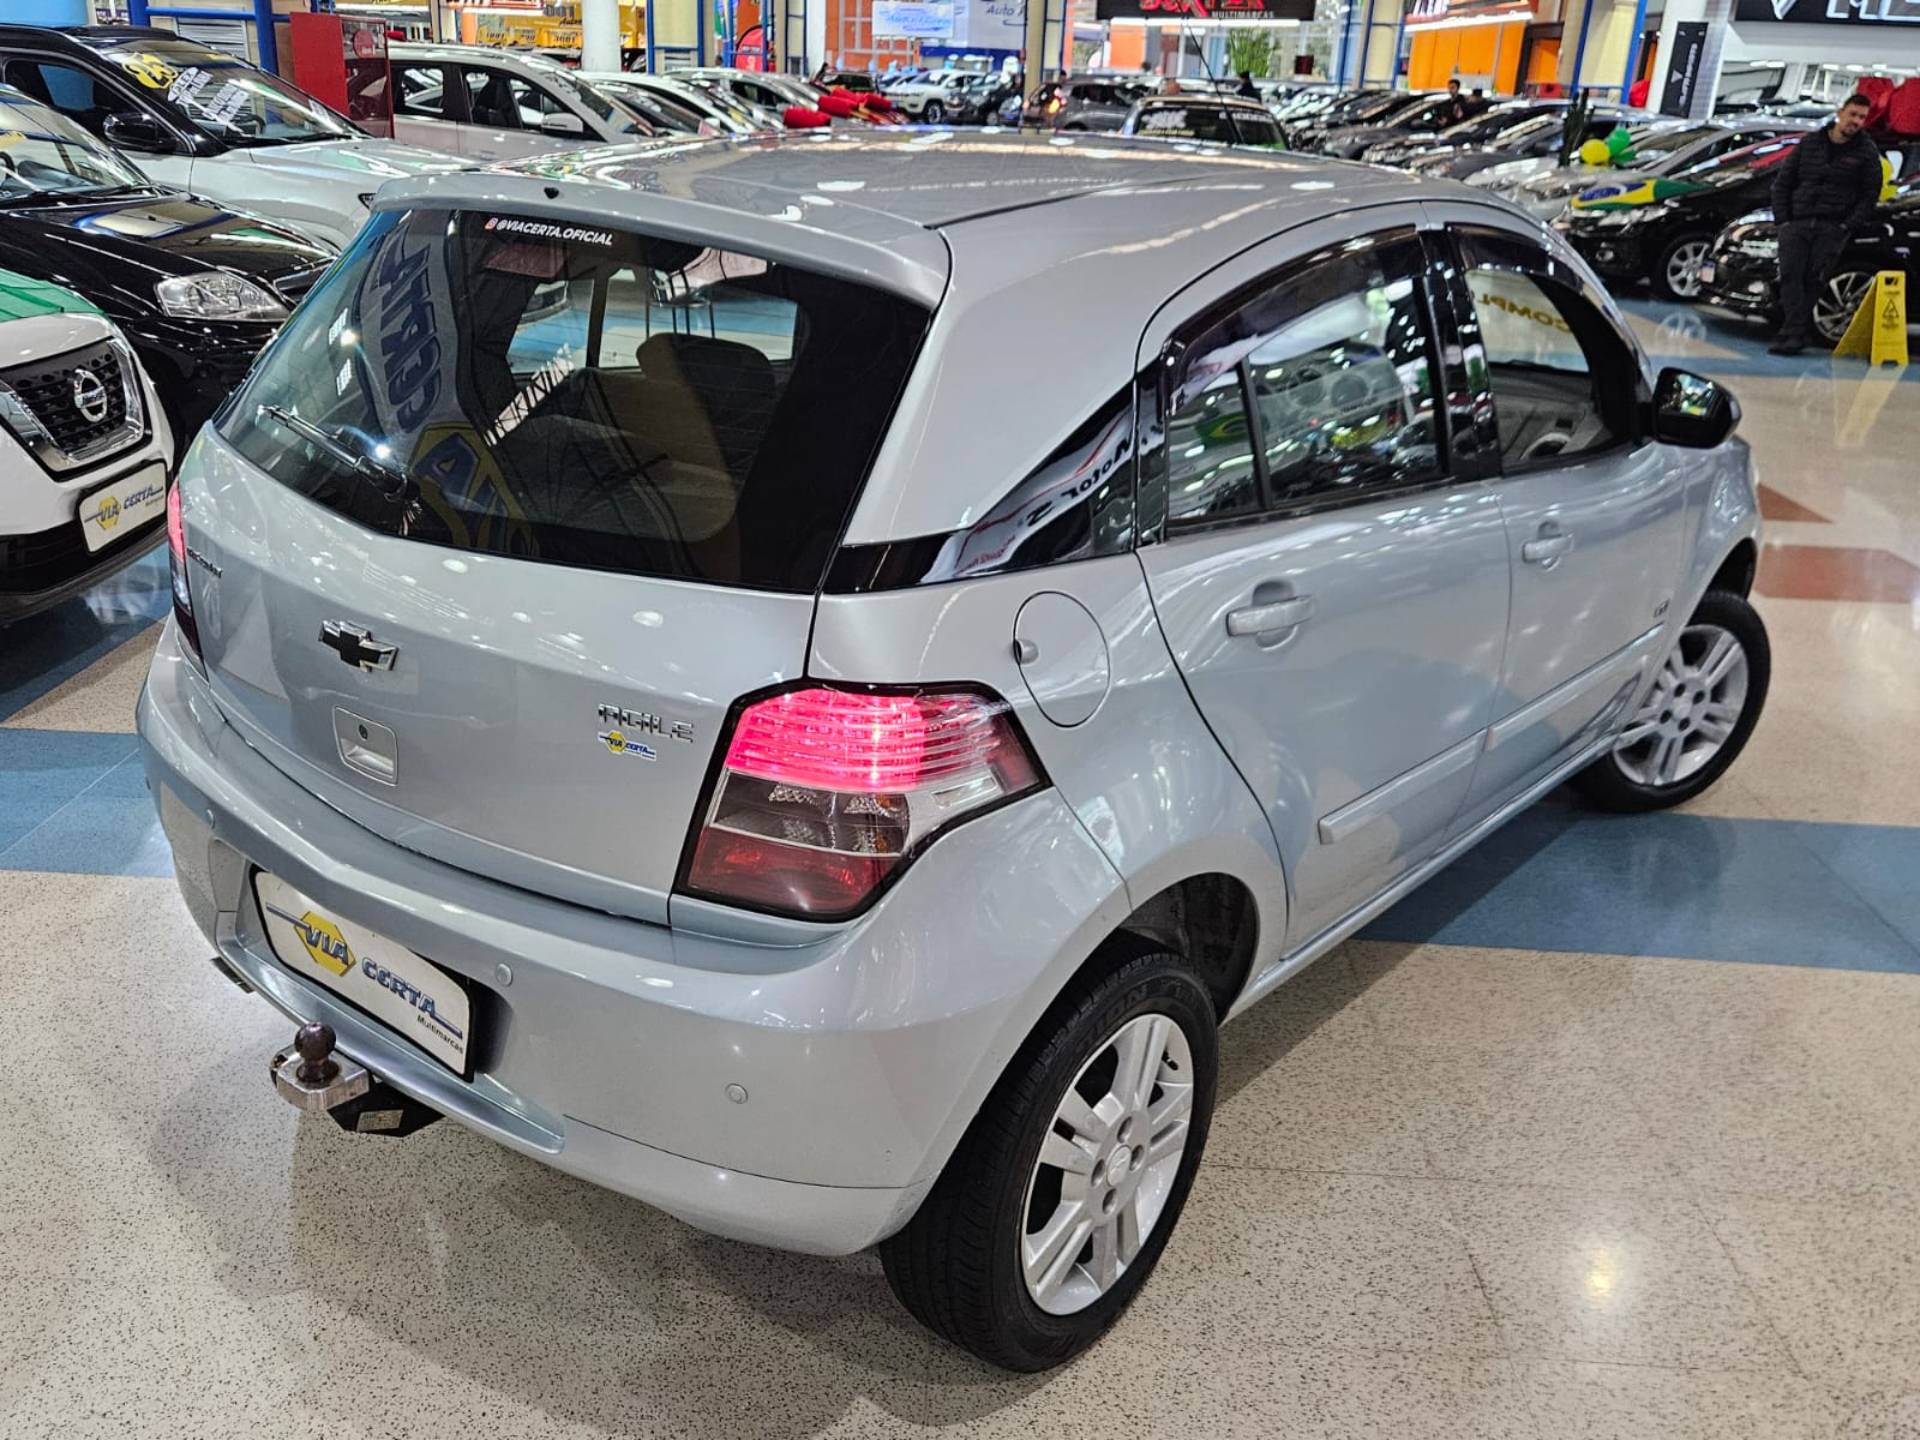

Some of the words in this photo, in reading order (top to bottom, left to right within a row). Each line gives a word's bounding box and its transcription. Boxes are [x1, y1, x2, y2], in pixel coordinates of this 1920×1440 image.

[495, 219, 614, 246] @VIACERTA.OFICIAL
[303, 922, 350, 967] VIA
[361, 955, 437, 1019] CERTA
[417, 1013, 464, 1055] Multimarcas
